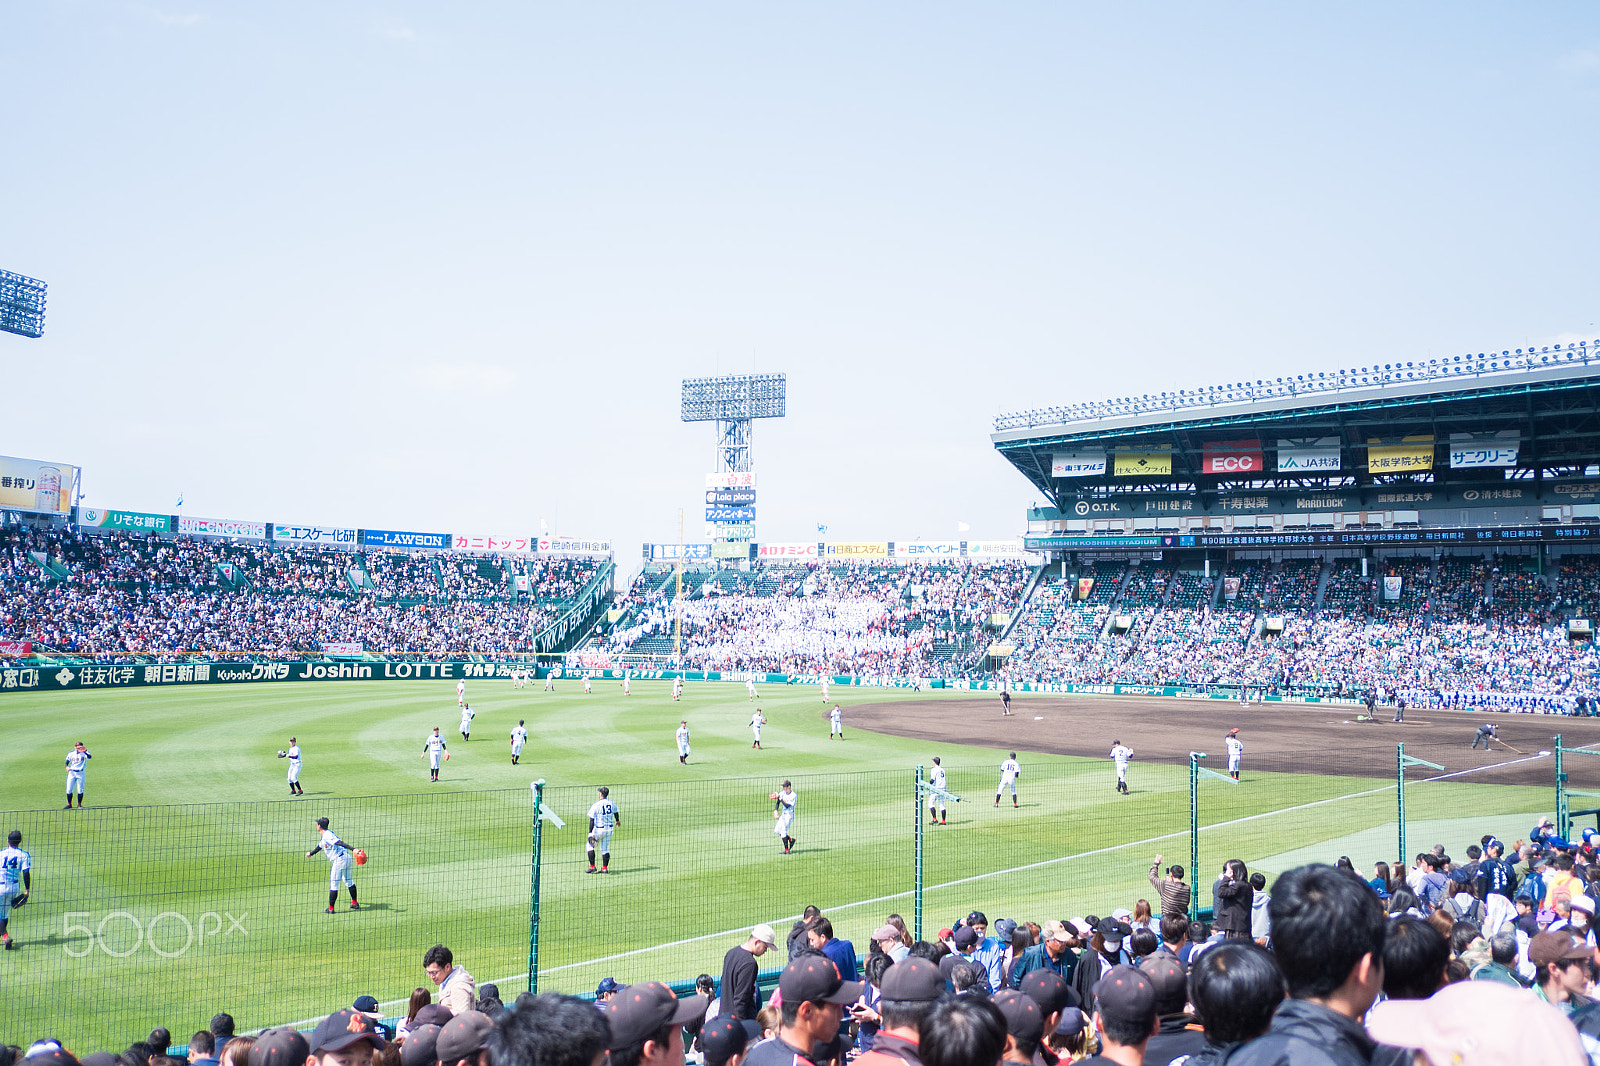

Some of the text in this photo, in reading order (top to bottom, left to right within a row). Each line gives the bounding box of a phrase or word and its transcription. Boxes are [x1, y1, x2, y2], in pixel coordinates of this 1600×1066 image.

[1301, 458, 1340, 468] JA共済
[1370, 455, 1432, 468] 大阪学院大学
[1452, 450, 1518, 464] サニクリーン
[1065, 463, 1104, 472] 東洋アルミ
[1212, 456, 1252, 471] ECC
[727, 473, 752, 486] 白波
[733, 492, 754, 502] place
[1378, 492, 1432, 502] 国際武道大学
[1481, 489, 1522, 500] 清水建設
[1092, 502, 1120, 512] O.T.K.
[1146, 500, 1192, 511] 戸田建設
[1218, 496, 1268, 510] 千寿製薬
[113, 514, 166, 529] りそな銀行
[290, 526, 355, 542] エスケー化研
[384, 534, 442, 546] LAWSON
[456, 536, 528, 550] カニトップ
[551, 540, 610, 552] 尼崎信用金庫
[908, 544, 958, 554] 日本ペイント
[759, 545, 816, 556] オロナミンC
[836, 545, 885, 554] 日商エステム
[78, 667, 134, 685] 住友化学
[144, 665, 210, 682] 朝日新聞
[217, 663, 290, 680] Kubota クボタ
[299, 663, 372, 678] Joshin
[384, 664, 453, 678] LOTTE
[462, 664, 495, 676] タカラ
[720, 672, 766, 682] SHIMNO
[1006, 763, 1015, 771] 16
[602, 804, 612, 816] 13
[2, 856, 18, 868] 14
